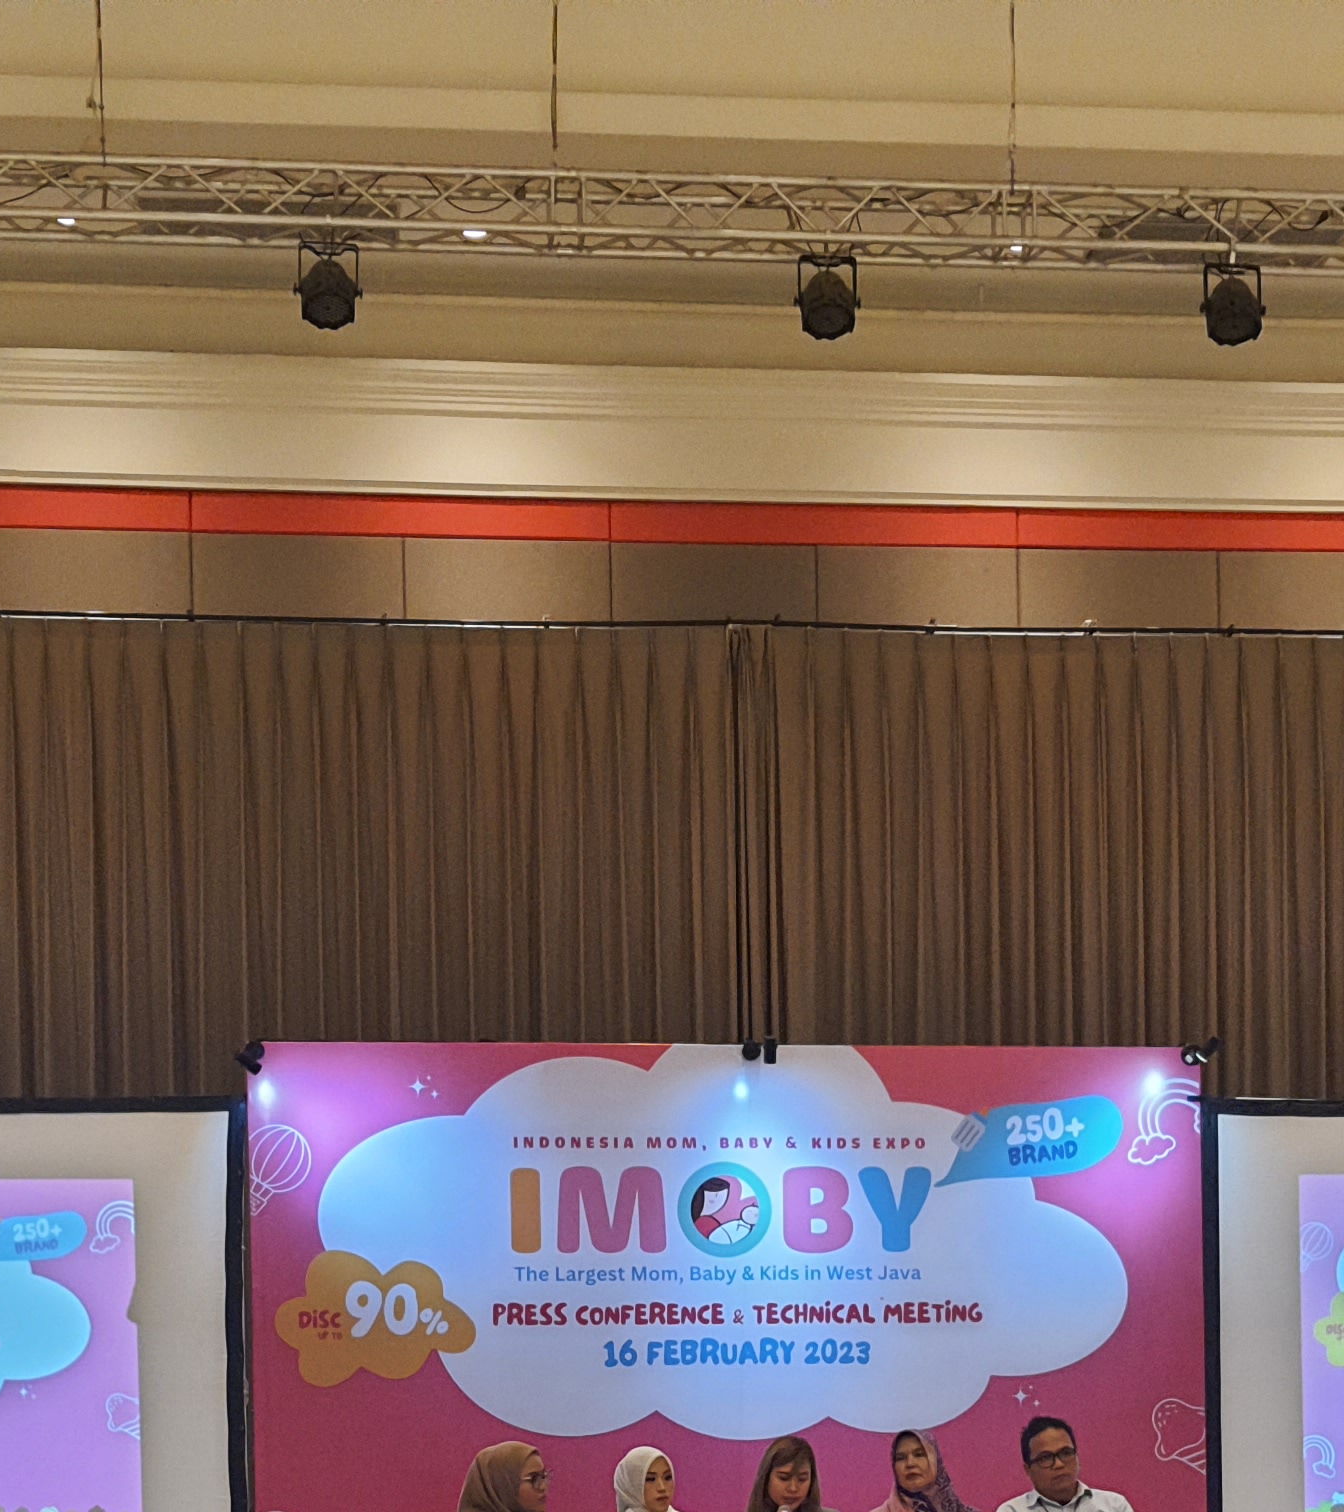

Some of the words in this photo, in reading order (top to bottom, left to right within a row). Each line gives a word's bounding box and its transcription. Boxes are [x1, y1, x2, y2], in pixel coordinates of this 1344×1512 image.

[1006, 1107, 1085, 1145] 250+
[513, 1136, 634, 1149] INDONESIA
[647, 1136, 707, 1151] MOM,
[719, 1136, 773, 1149] BABY
[785, 1136, 798, 1149] &
[811, 1137, 861, 1149] KIDS
[873, 1137, 926, 1149] EXPO
[1008, 1140, 1078, 1166] BRAND
[510, 1161, 932, 1258] IMOBY
[13, 1218, 62, 1242] 250+
[14, 1239, 59, 1254] BRAND
[514, 1266, 549, 1282] The
[555, 1266, 626, 1285] Largest
[631, 1266, 684, 1284] Mom,
[690, 1265, 736, 1285] Baby
[742, 1266, 755, 1281] &
[760, 1265, 799, 1281] Kids
[805, 1265, 821, 1281] in
[826, 1266, 873, 1281] West
[878, 1266, 922, 1281] Java
[345, 1280, 449, 1338] 90%
[492, 1302, 568, 1326] PRESS
[575, 1302, 725, 1326] CONFERENCE
[732, 1309, 745, 1325] &
[603, 1339, 638, 1367] 16
[647, 1337, 795, 1366] FEBRUARY
[804, 1338, 871, 1365] 2023
